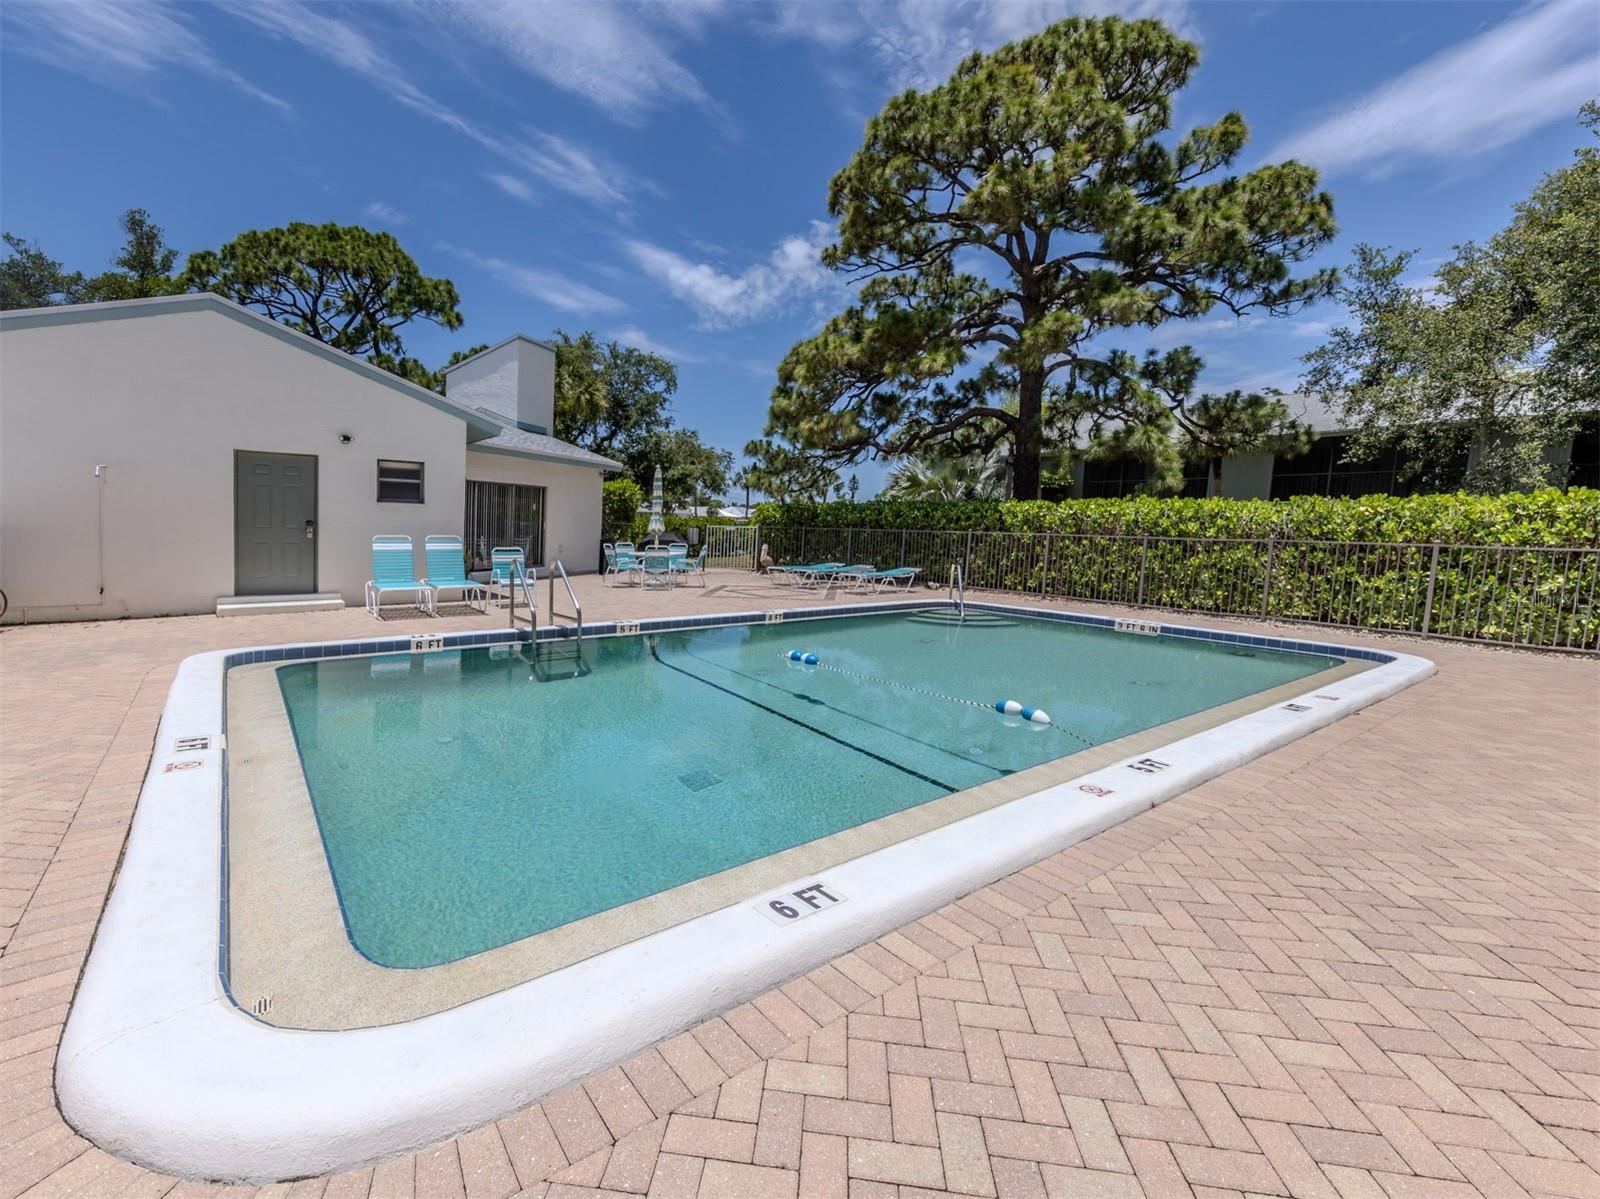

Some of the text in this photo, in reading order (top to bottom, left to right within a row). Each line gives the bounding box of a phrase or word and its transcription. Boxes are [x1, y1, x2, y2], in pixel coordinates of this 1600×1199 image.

[620, 623, 639, 634] 5 FT
[1126, 623, 1137, 631] FT
[428, 639, 442, 649] FT
[1127, 758, 1170, 773] 5 FT
[768, 883, 840, 919] 6 FT
